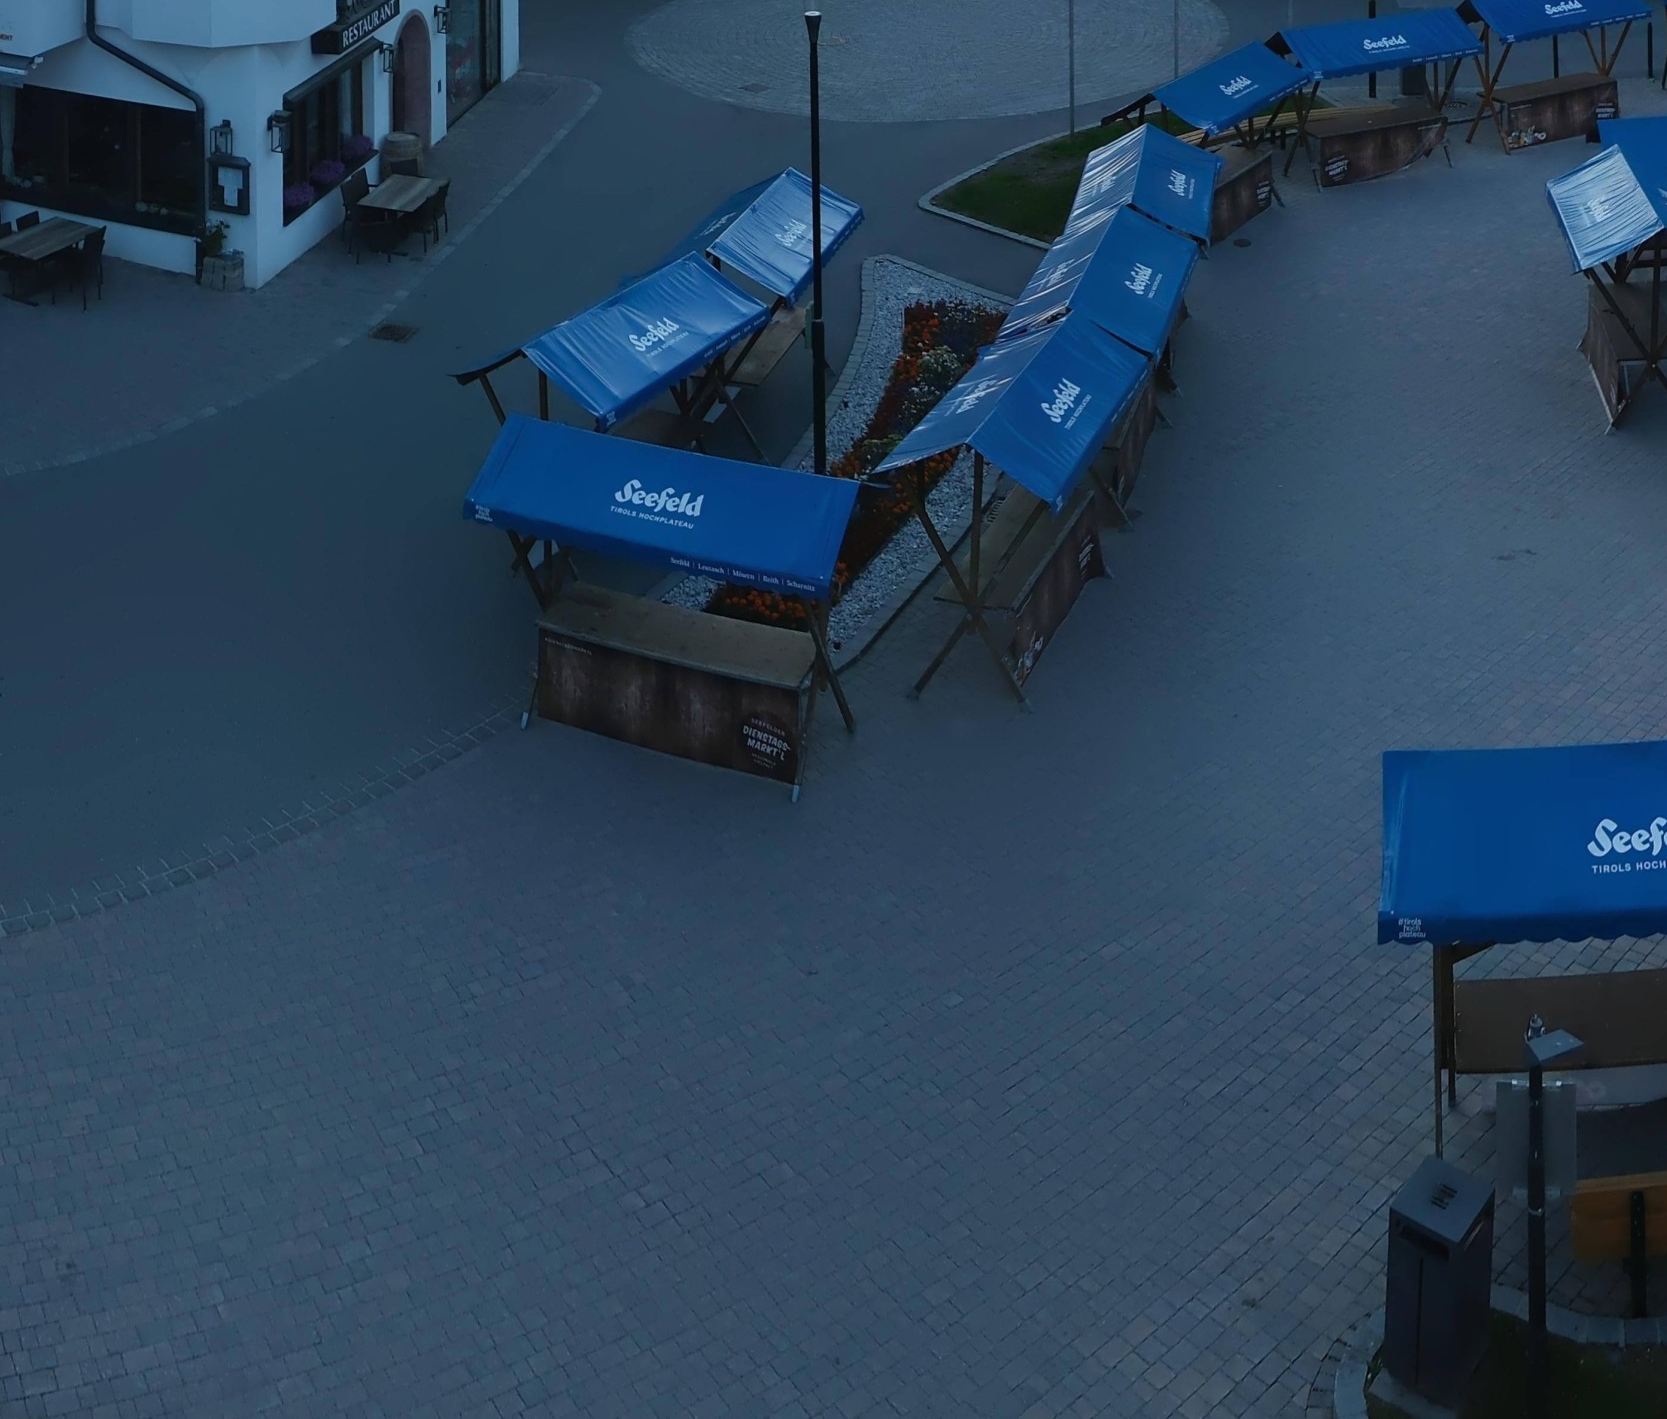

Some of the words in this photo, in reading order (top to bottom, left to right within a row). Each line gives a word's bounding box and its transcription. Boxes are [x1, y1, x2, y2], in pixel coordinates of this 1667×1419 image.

[1545, 0, 1583, 15] Seefeld
[342, 0, 398, 49] RESTAURANT
[1363, 33, 1407, 50] Seefeld
[628, 316, 680, 353] Seefeld
[1039, 377, 1081, 423] Seefeld
[613, 478, 705, 518] Seefeld
[610, 505, 637, 518] TIROLS
[638, 510, 695, 530] HOCHPLATEAU
[742, 724, 791, 751] DIENSTAGS-
[747, 737, 785, 762] MARKT'L
[1591, 862, 1632, 875] TIROLS
